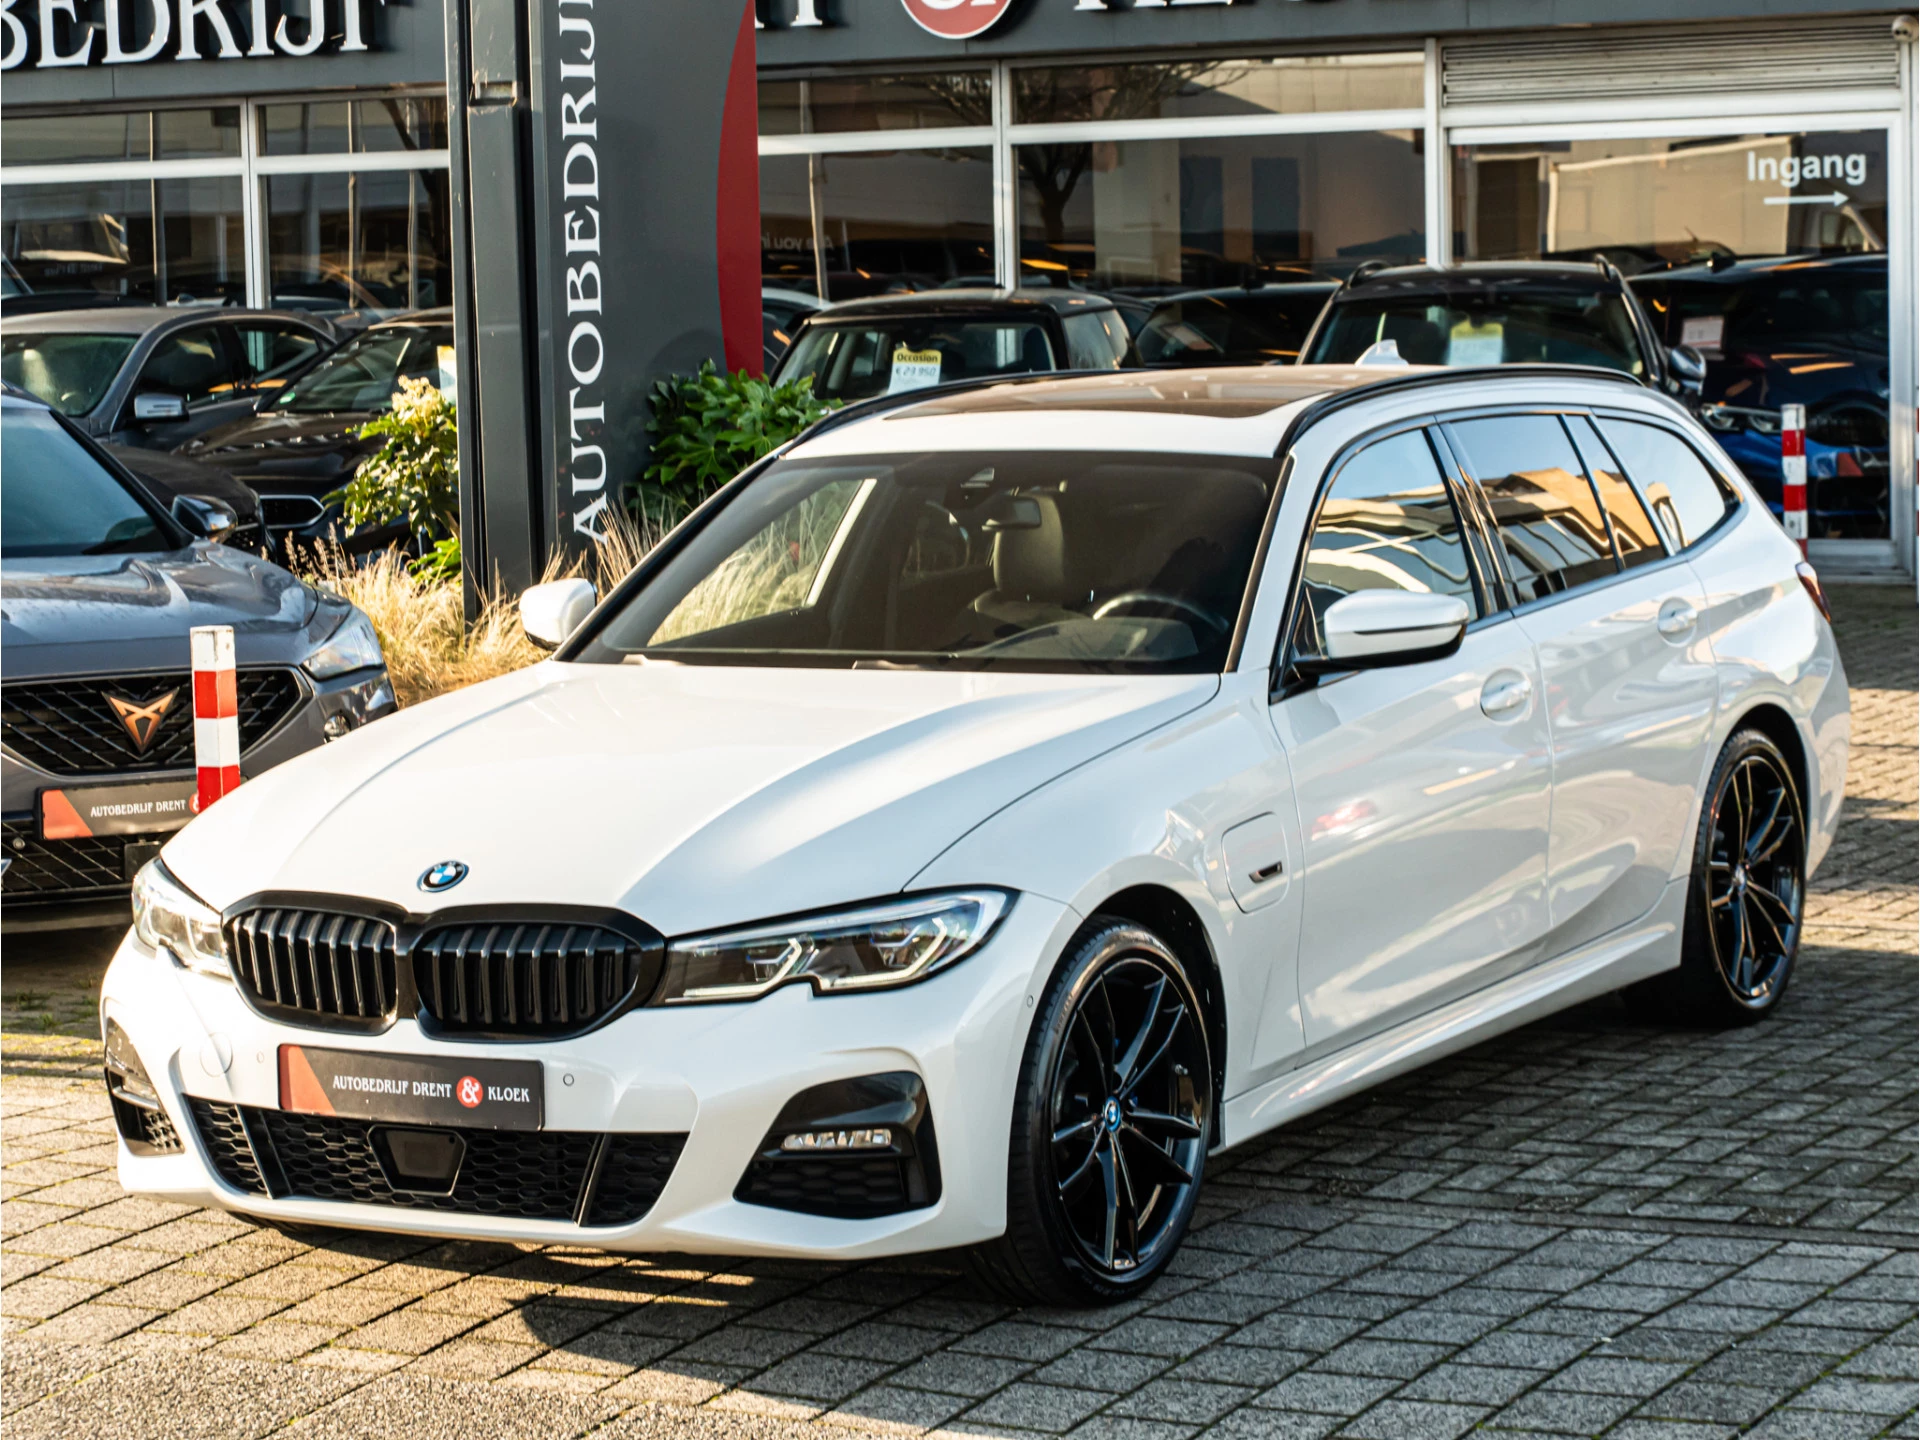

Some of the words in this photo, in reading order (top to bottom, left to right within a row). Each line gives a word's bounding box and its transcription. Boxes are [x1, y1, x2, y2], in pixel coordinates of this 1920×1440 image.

[1747, 150, 1867, 188] Ingang
[896, 353, 938, 363] Occasion
[90, 802, 153, 818] AUTOBEDRIJF
[155, 799, 187, 813] DRENT
[332, 1075, 409, 1095] AUTOBEDRIJF
[412, 1081, 452, 1098] DRENT
[461, 1078, 480, 1104] &
[487, 1086, 530, 1103] KLOEK
